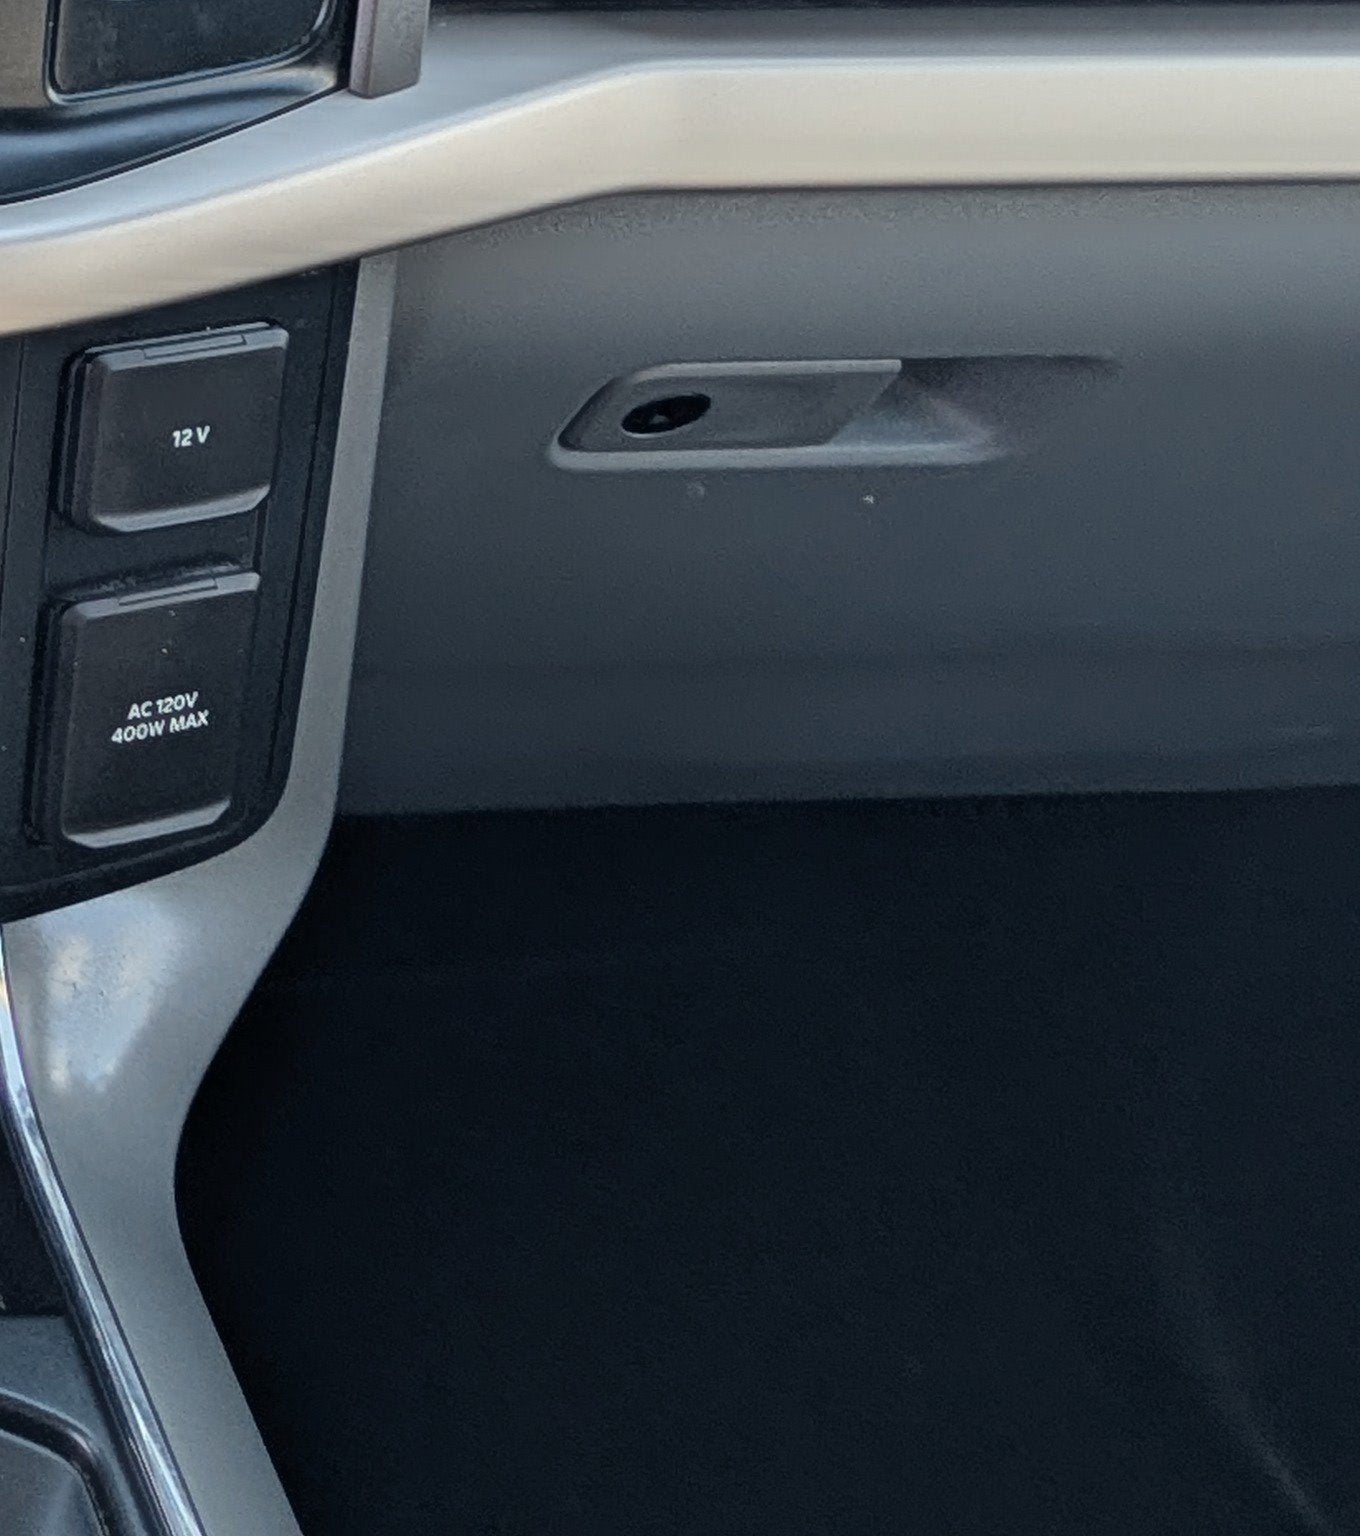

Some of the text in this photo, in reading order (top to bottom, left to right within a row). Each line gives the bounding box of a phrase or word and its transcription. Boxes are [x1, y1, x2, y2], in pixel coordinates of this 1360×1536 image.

[173, 426, 211, 448] 12 V
[127, 691, 199, 721] AC 120V
[110, 710, 210, 744] 400W MAX
